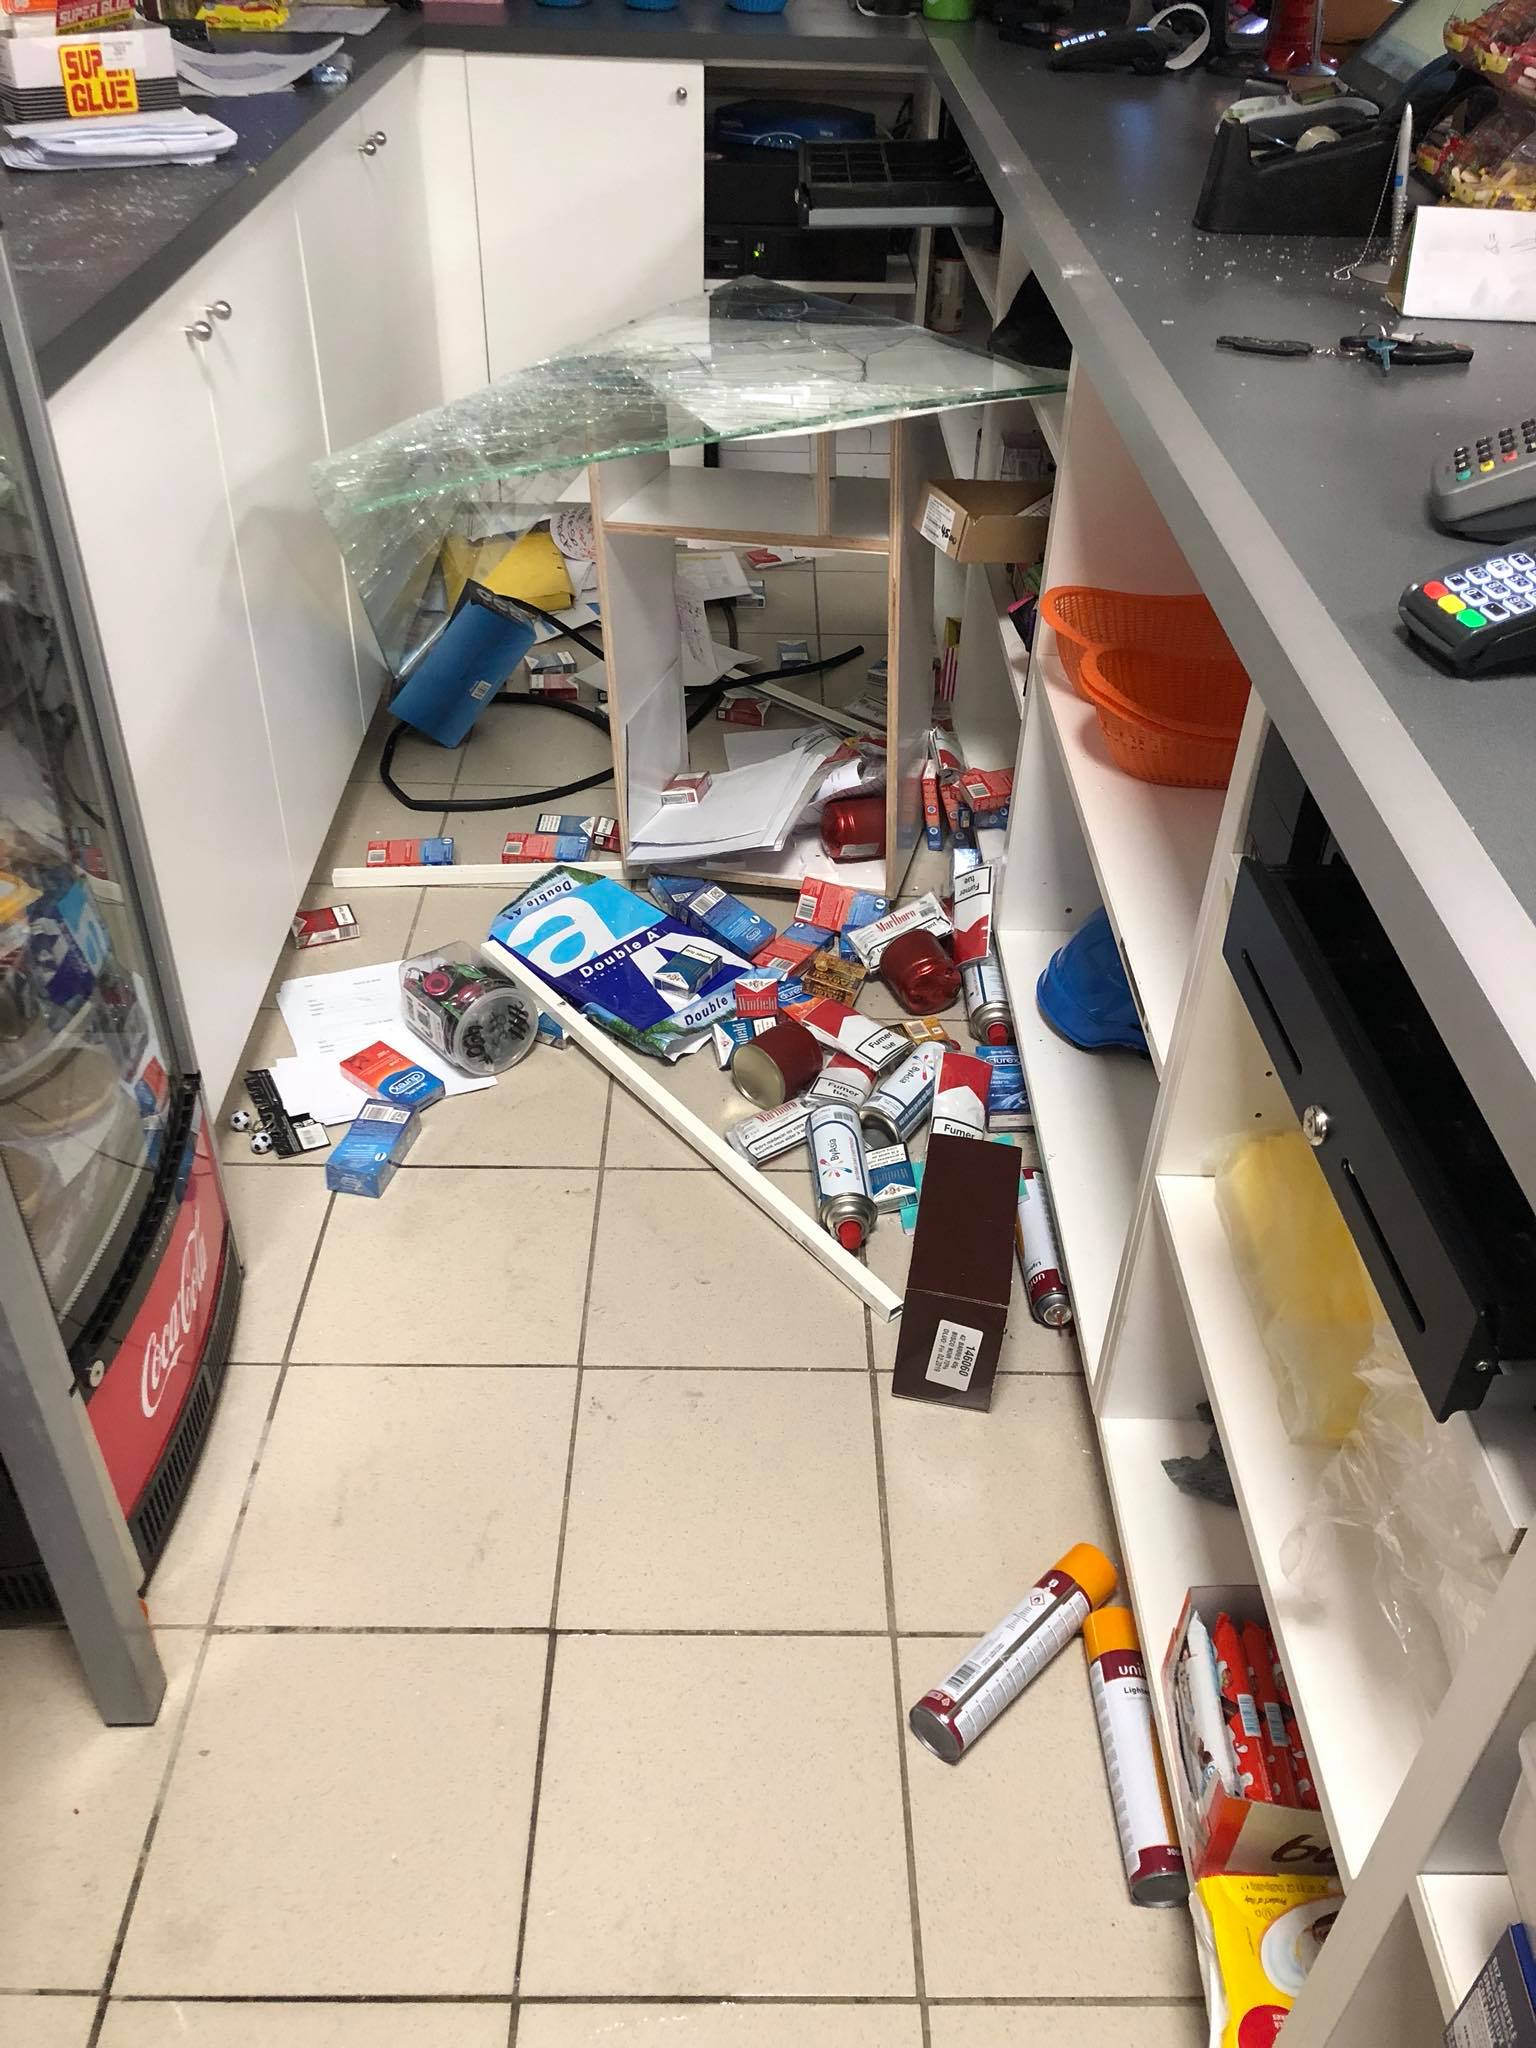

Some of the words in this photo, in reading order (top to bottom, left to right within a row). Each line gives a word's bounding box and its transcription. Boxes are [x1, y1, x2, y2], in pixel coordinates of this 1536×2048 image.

[65, 49, 129, 80] SUP
[71, 80, 133, 112] GLUE
[526, 880, 572, 907] Double
[579, 941, 642, 978] Double
[646, 930, 661, 942] A
[684, 997, 728, 1026] Double
[738, 996, 777, 1012] Winfield
[868, 1032, 893, 1049] Fumer
[882, 1041, 896, 1050] tue
[390, 1072, 422, 1093] durex
[827, 1082, 860, 1097] Fumer
[944, 1123, 976, 1138] Fumer
[828, 1138, 841, 1161] ByAsia
[958, 1346, 976, 1377] 146060
